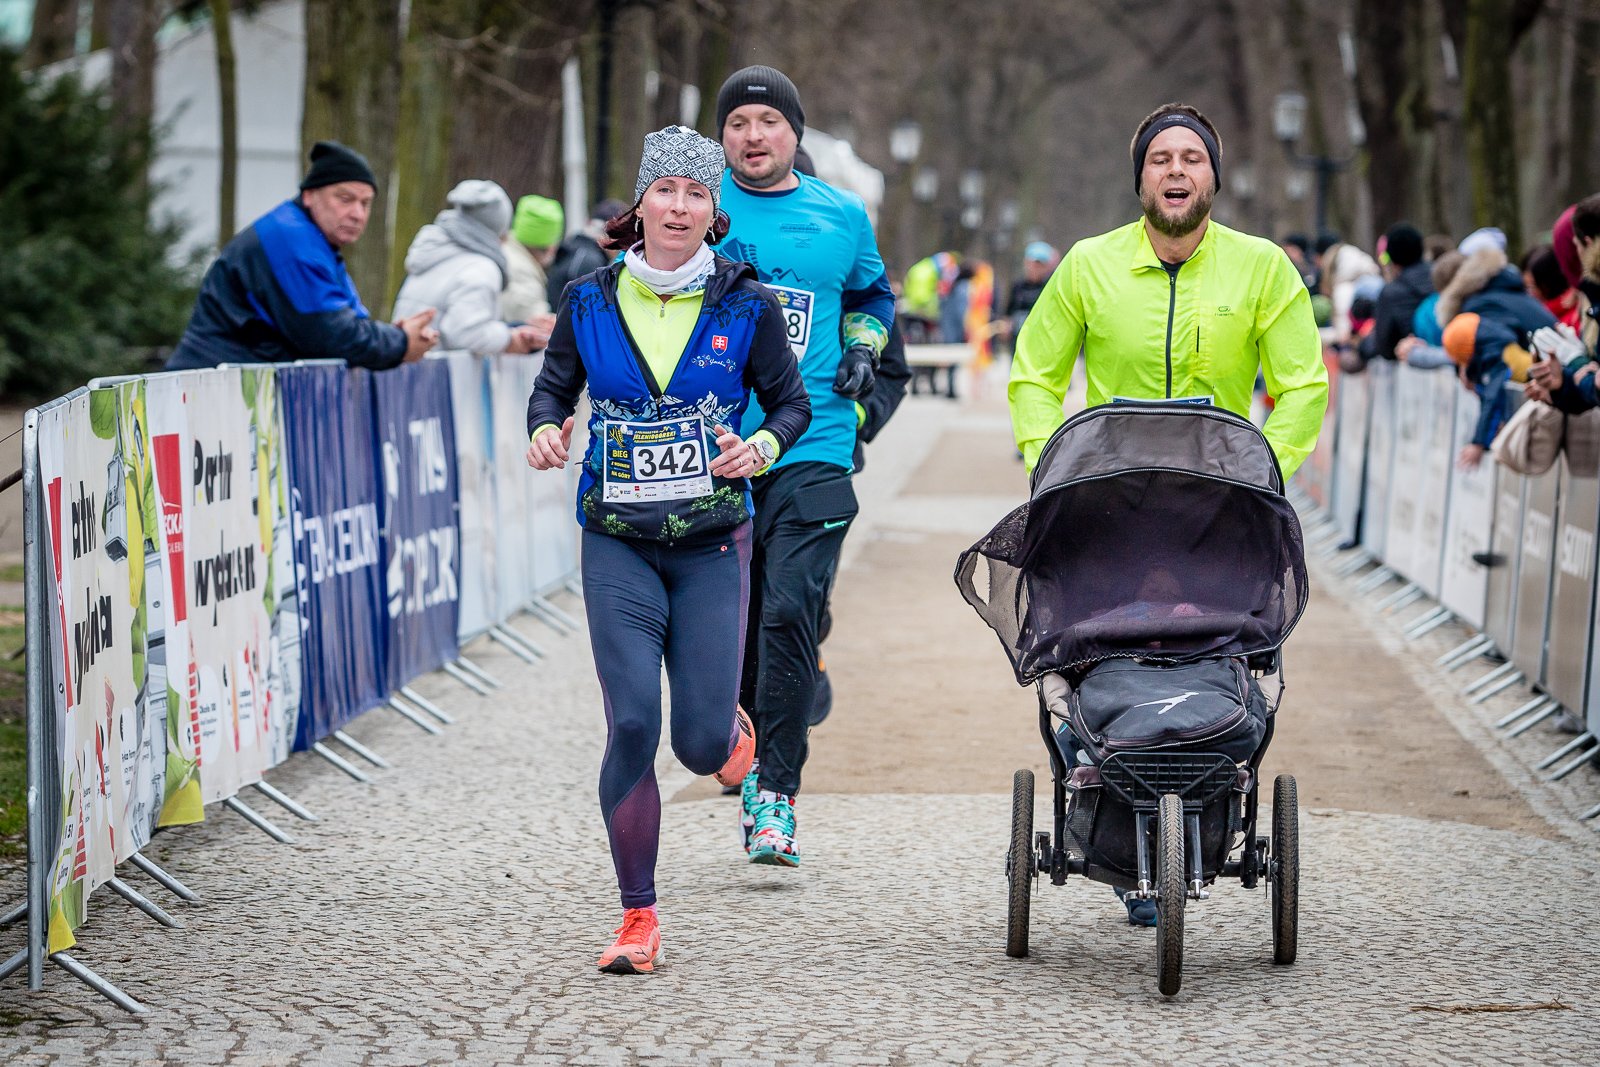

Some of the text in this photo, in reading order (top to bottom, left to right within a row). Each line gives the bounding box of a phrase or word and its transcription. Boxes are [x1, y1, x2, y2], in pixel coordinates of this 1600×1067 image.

[787, 312, 801, 338] 8
[612, 449, 628, 459] BIEG
[638, 443, 699, 477] 342
